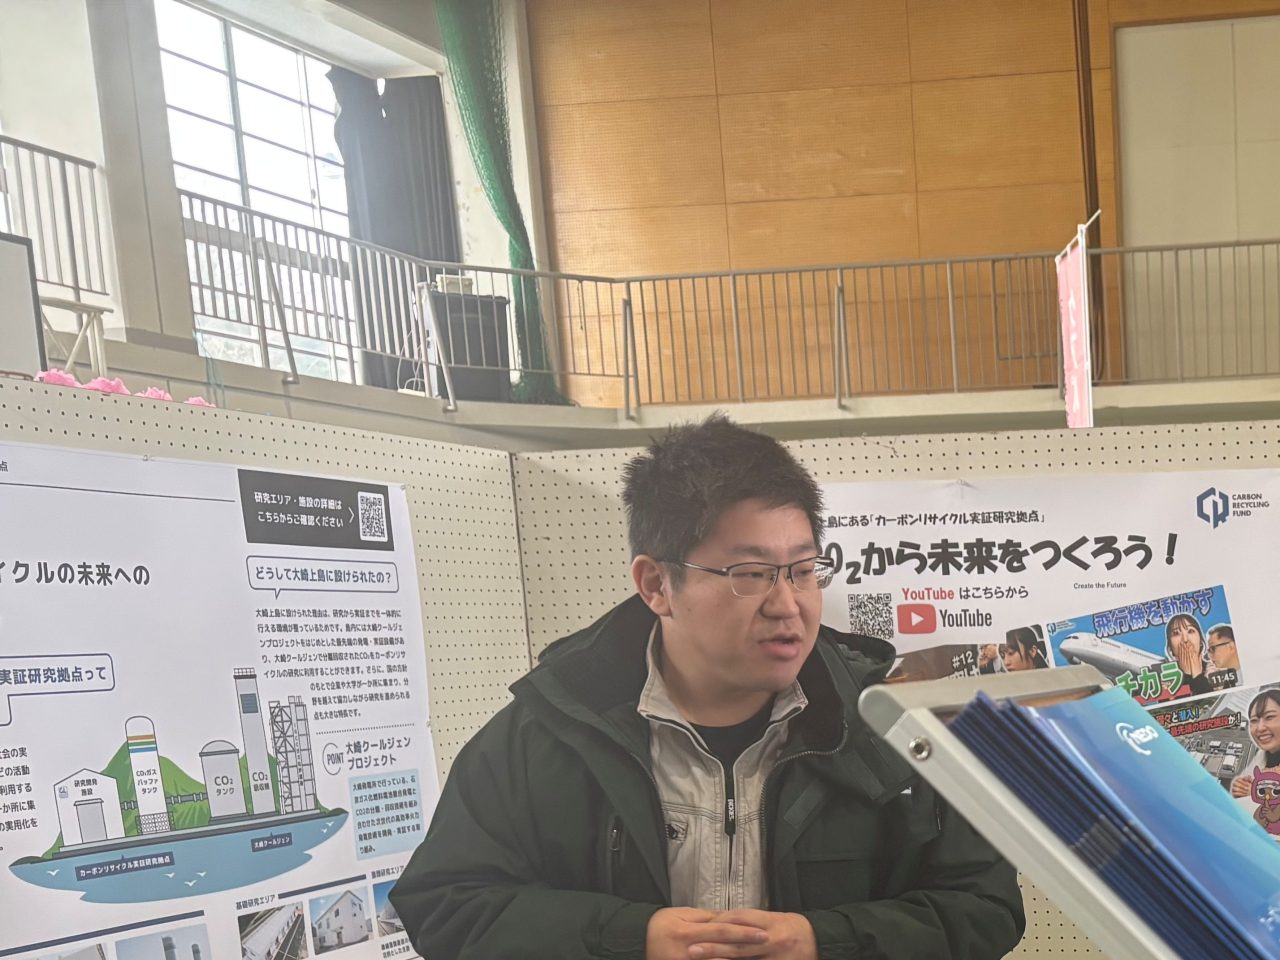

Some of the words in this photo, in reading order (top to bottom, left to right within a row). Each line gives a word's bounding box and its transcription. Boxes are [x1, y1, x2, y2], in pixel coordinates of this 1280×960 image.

[254, 492, 342, 510] 研究エリア・施設の詳細は
[1232, 501, 1270, 509] RECYCLING
[258, 511, 343, 527] こちらからご確認ください
[818, 533, 1178, 584] O2から未来をつくろう!
[256, 566, 391, 584] どうして大崎上島に設けられたの?
[902, 587, 954, 600] YouTube
[959, 586, 1029, 600] はこちらから
[939, 609, 992, 627] YouTube
[1094, 588, 1214, 638] 飛行機を動かす
[951, 651, 974, 668] #12
[1115, 661, 1184, 699] チカラ
[1211, 672, 1235, 684] 11:45
[345, 737, 411, 755] 大崎クールジェン
[327, 752, 344, 766] POINT
[347, 754, 397, 771] プロジェクト
[214, 775, 233, 786] CO2
[252, 771, 268, 782] CO2
[216, 787, 234, 796] タンク
